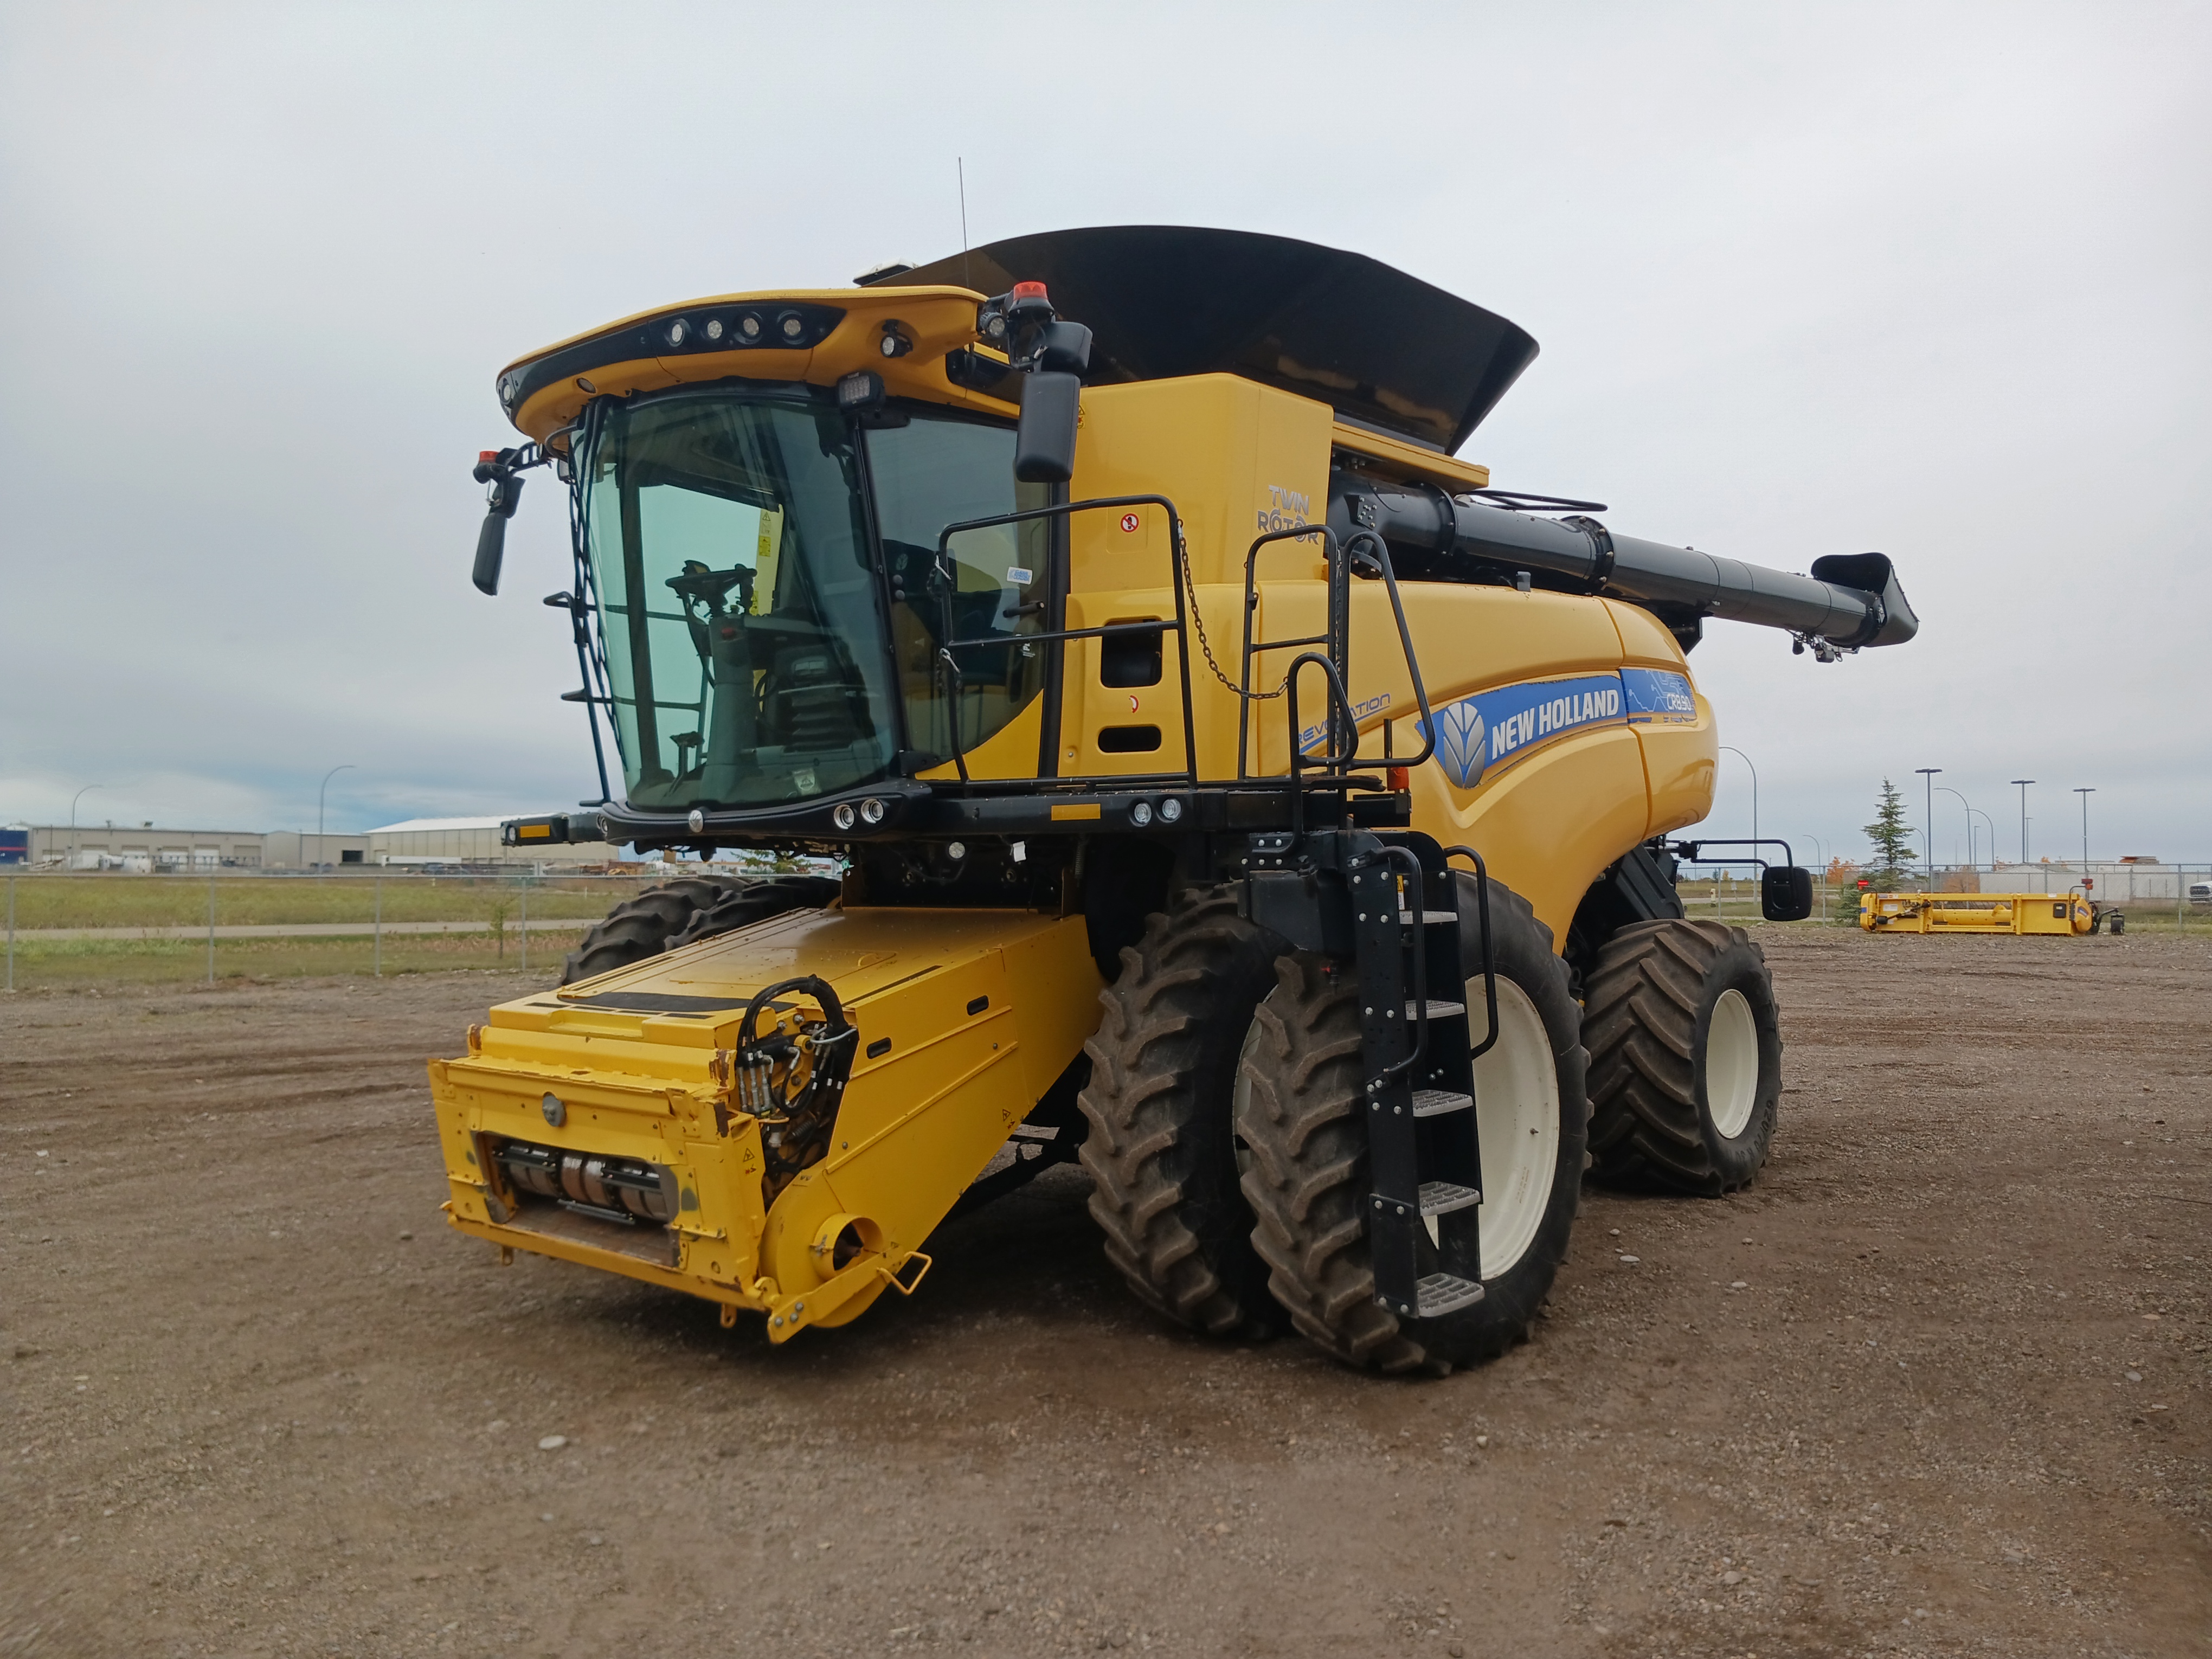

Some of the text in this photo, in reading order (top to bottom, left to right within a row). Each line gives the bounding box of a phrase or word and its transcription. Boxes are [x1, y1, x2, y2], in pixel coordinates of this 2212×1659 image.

[1269, 485, 1309, 516] TWIN
[1257, 508, 1319, 545] ROTOR
[1492, 689, 1619, 760] NEW HOLLAND
